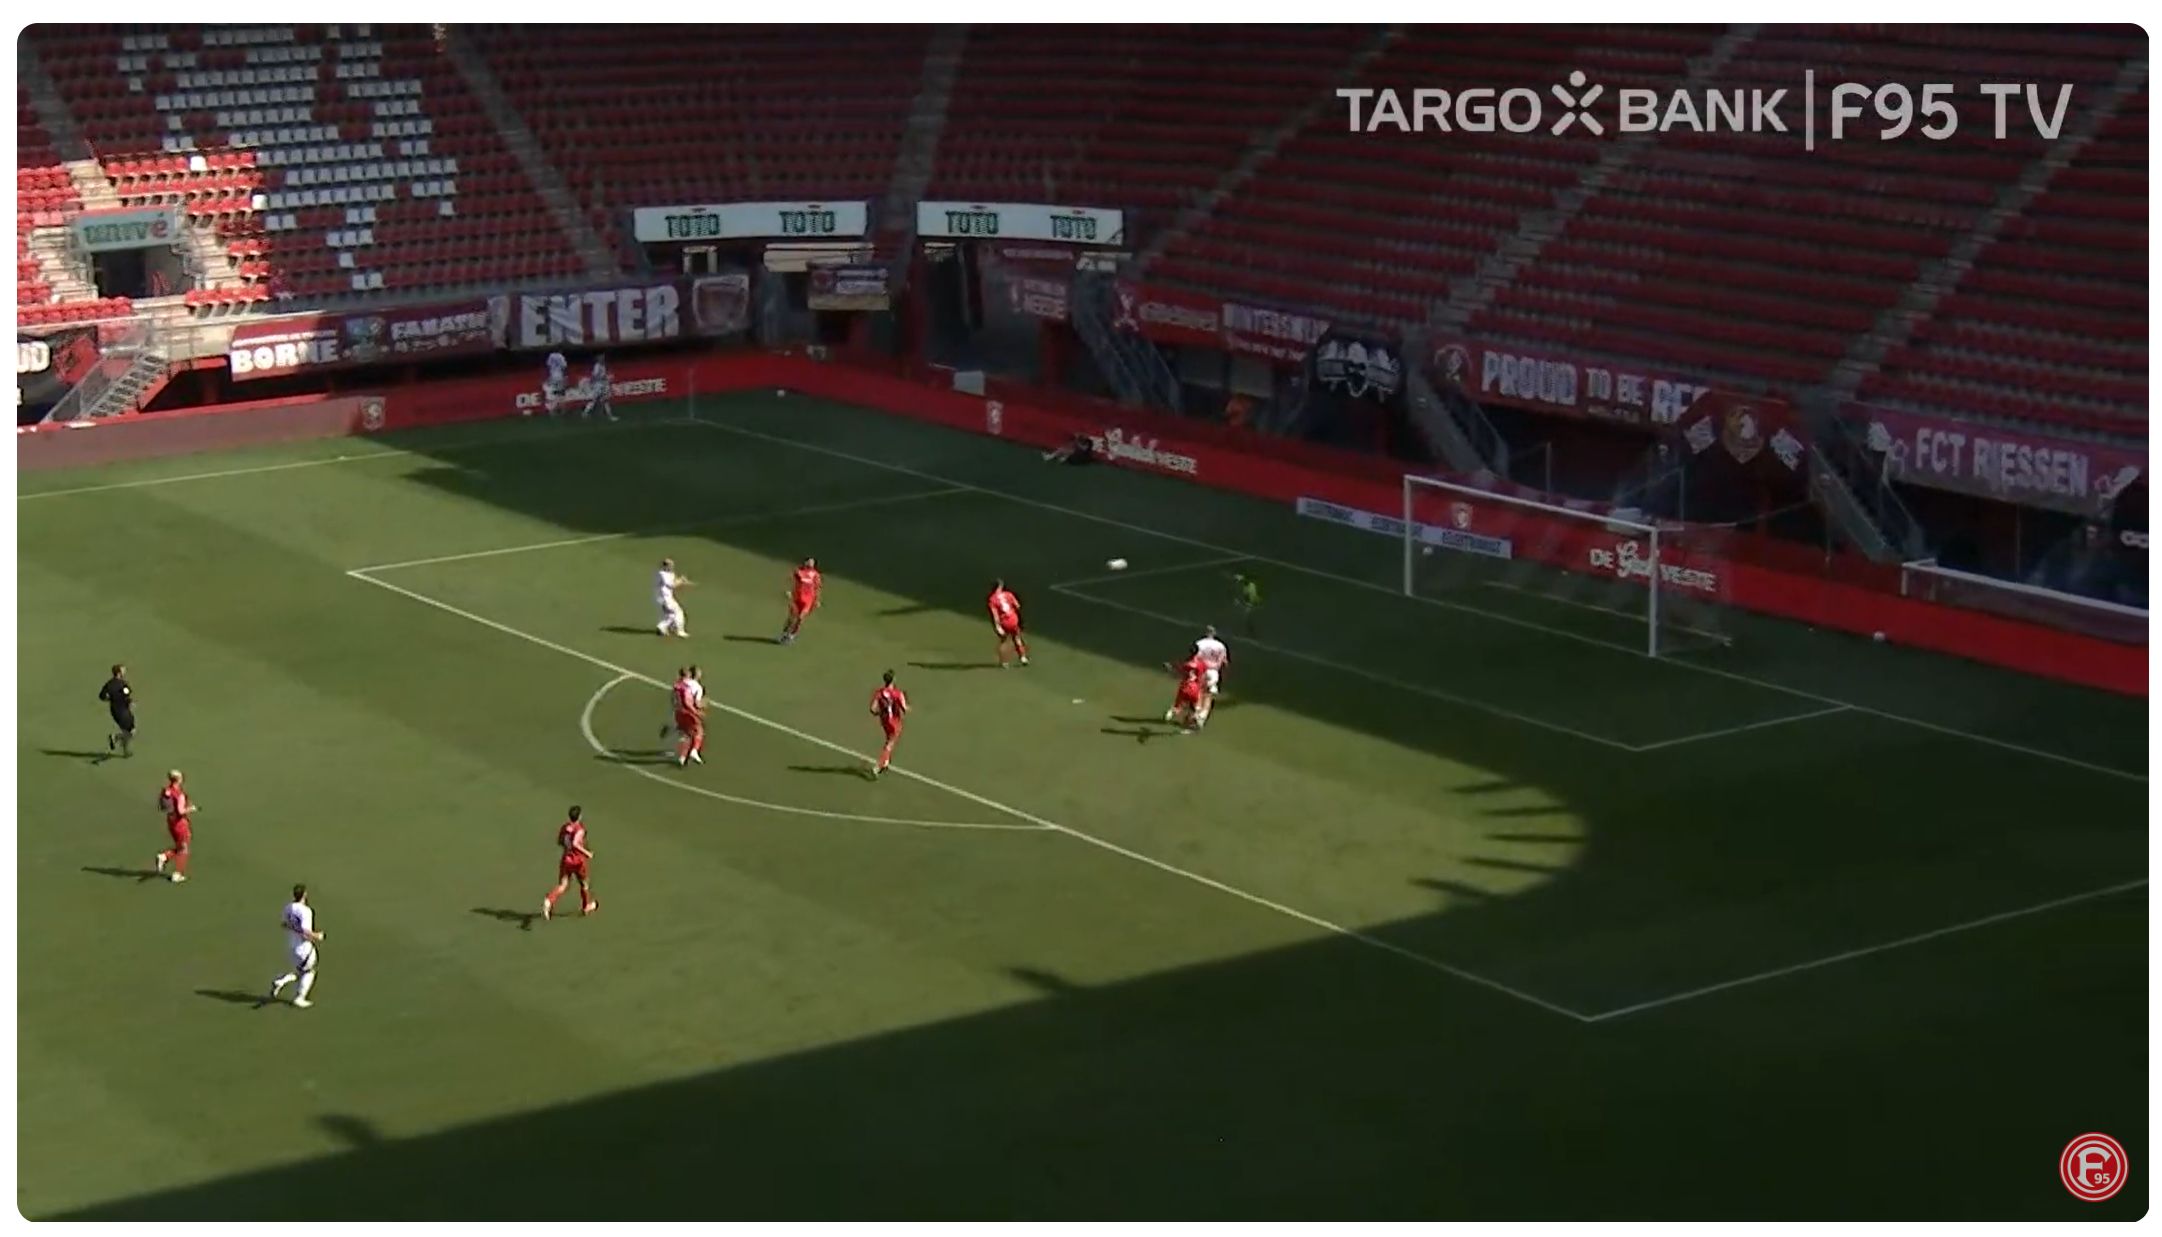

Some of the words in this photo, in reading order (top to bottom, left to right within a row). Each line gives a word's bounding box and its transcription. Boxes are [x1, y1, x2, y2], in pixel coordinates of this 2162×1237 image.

[664, 213, 720, 238] TOTO
[778, 210, 834, 234] TOTO
[945, 210, 999, 236] TOTO
[1050, 214, 1097, 240] TOTO
[520, 285, 681, 347] ENTER
[229, 339, 338, 373] BORNE
[1481, 350, 1578, 406] PROUD
[1585, 367, 1612, 400] TO
[1617, 374, 1647, 406] BE
[1915, 427, 1966, 477] FCT
[1973, 437, 2089, 498] RIESSEN
[1590, 548, 1615, 569] DE
